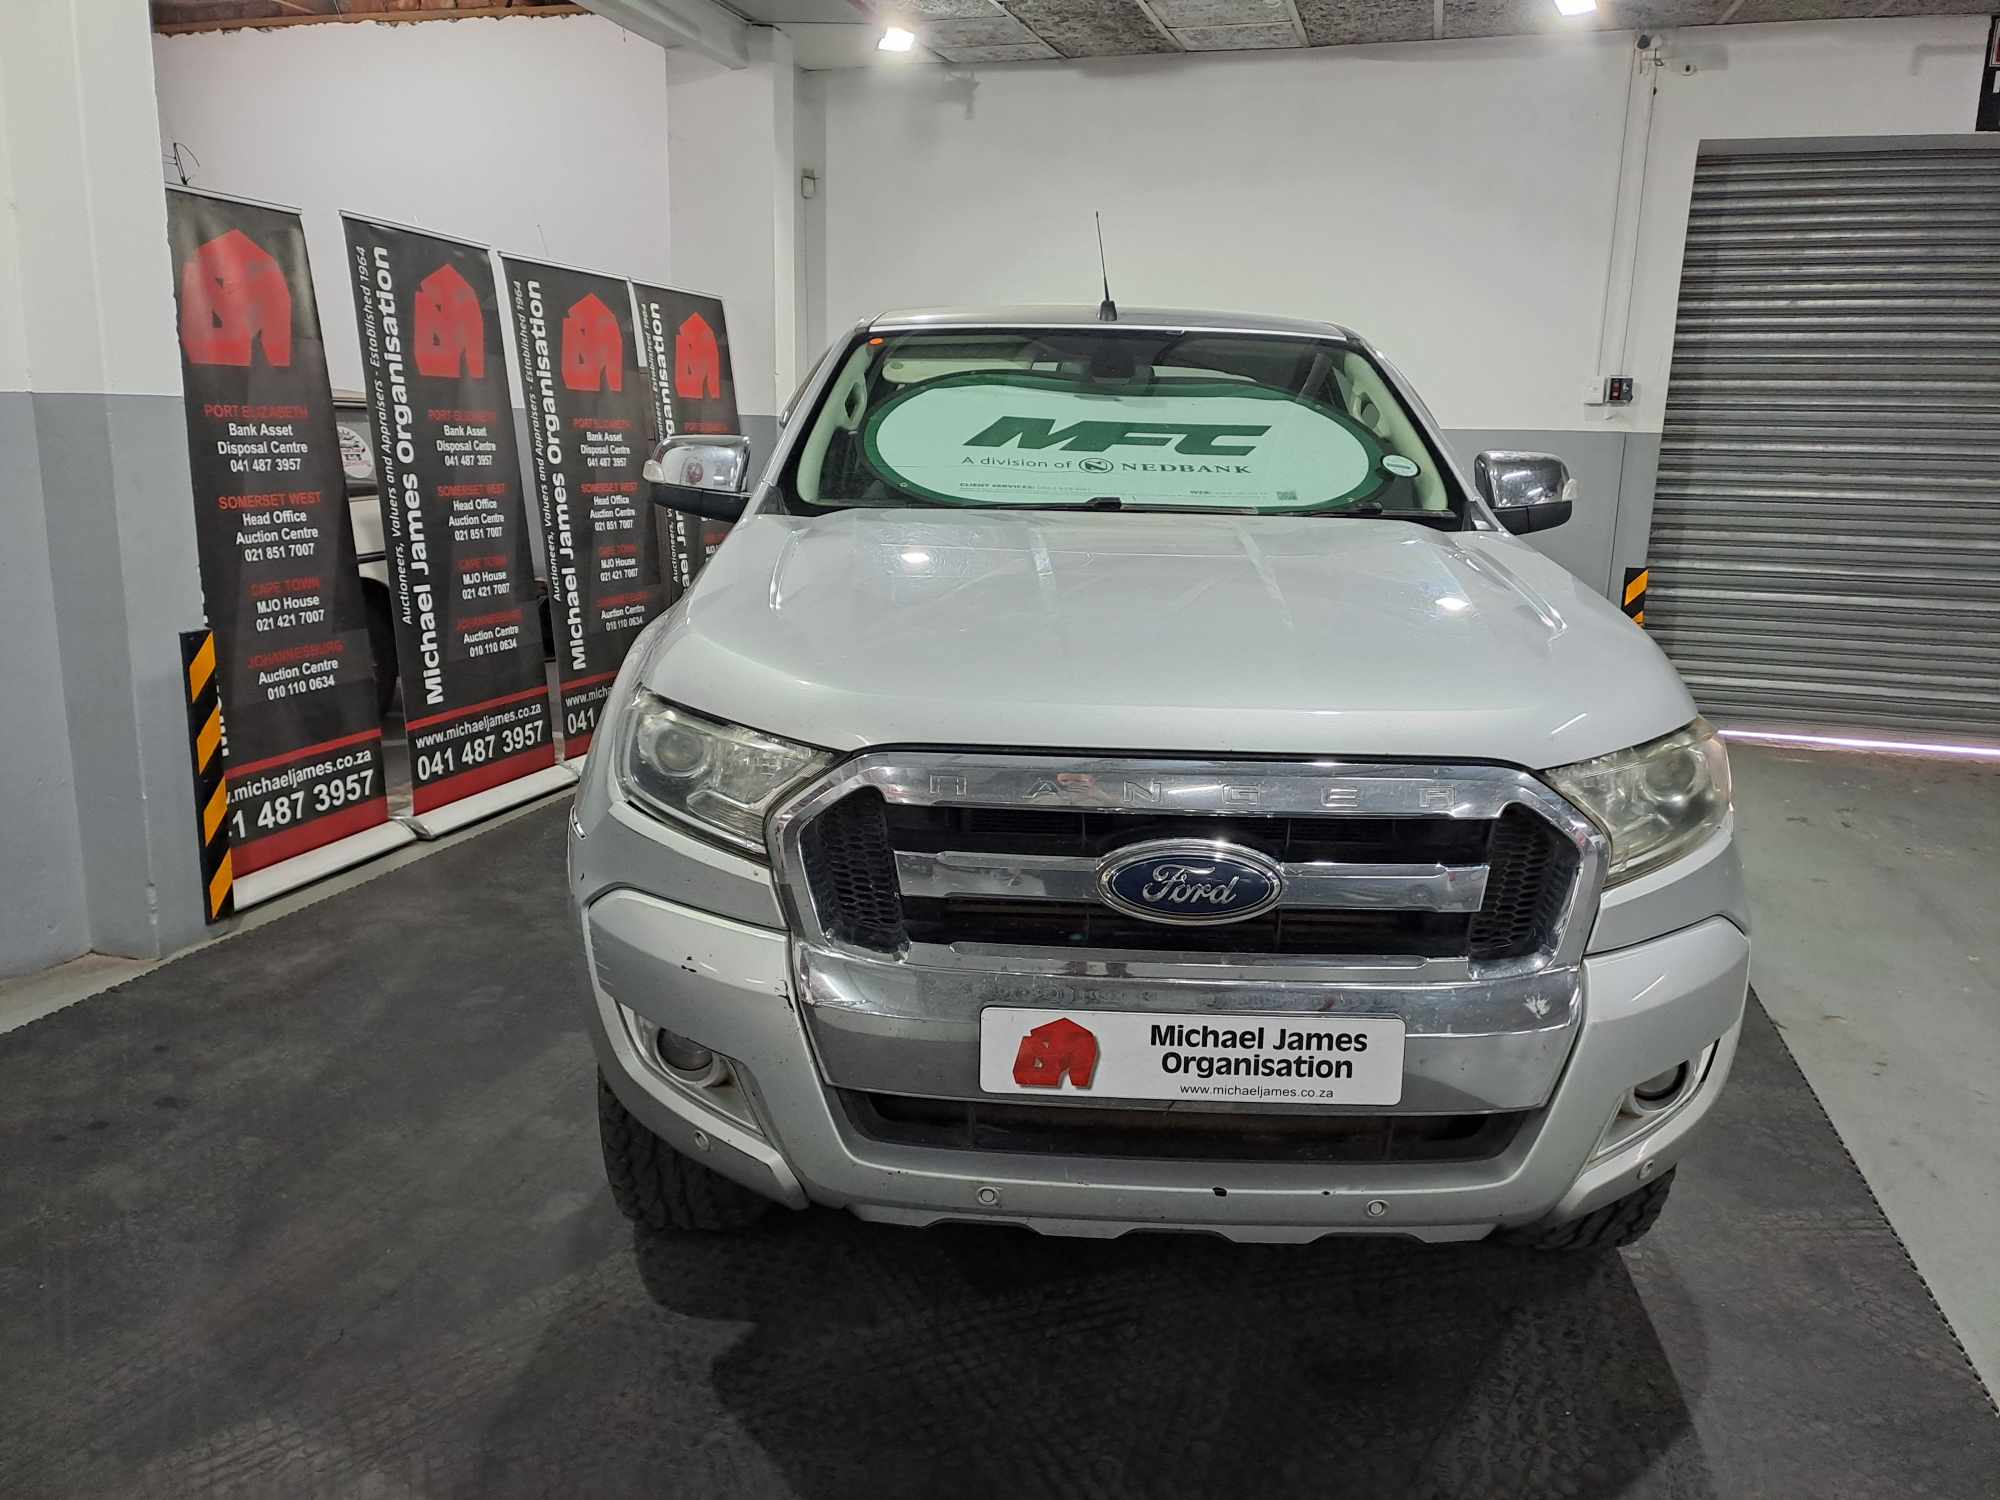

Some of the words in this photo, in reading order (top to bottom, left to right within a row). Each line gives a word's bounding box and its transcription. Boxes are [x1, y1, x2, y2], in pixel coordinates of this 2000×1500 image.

[355, 245, 370, 282] 1964
[359, 284, 381, 367] Established
[373, 246, 415, 464] Organisation
[527, 280, 562, 465] Organisation
[374, 379, 392, 453] Appraisers
[228, 423, 258, 437] Bank
[260, 423, 293, 437] Asset
[443, 425, 465, 437] Bank
[466, 426, 487, 437] Asset
[962, 415, 1272, 456] MFC
[217, 441, 268, 456] Disposal
[270, 441, 308, 454] Centre
[436, 440, 472, 453] Disposal
[473, 441, 497, 451] Centre
[230, 460, 249, 473] 041
[252, 459, 272, 472] 487
[275, 458, 302, 472] 3957
[383, 456, 395, 484] and
[444, 455, 459, 466] 041
[536, 458, 547, 481] and
[962, 456, 975, 465] A
[980, 456, 1048, 469] division
[1054, 460, 1073, 469] of
[1122, 463, 1252, 474] NEDBANK
[218, 493, 287, 509] SOMERSET
[288, 491, 321, 505] WEST
[387, 486, 402, 538] Valuers
[453, 500, 473, 511] Head
[475, 498, 497, 510] Office
[541, 484, 552, 527] Valuers
[242, 512, 271, 526] Head
[273, 510, 308, 524] Office
[402, 474, 429, 576] James
[448, 514, 480, 527] Auction
[481, 512, 505, 524] Centre
[552, 472, 574, 560] James
[235, 530, 279, 545] Auction
[281, 526, 319, 540] Centre
[454, 530, 469, 541] 021
[244, 548, 264, 562] 021
[266, 546, 286, 560] 851
[288, 543, 315, 557] 7007
[462, 573, 481, 585] MJO
[482, 571, 507, 583] House
[547, 531, 561, 602] Auctioneers,
[395, 542, 412, 625] Auctioneers,
[462, 588, 476, 600] 021
[477, 586, 491, 596] 421
[256, 599, 281, 614] MJO
[283, 596, 320, 610] House
[256, 617, 275, 632] 021
[277, 614, 297, 627] 421
[299, 609, 325, 624] 7007
[562, 567, 586, 671] Michael
[413, 584, 444, 705] Michael
[463, 629, 494, 644] Auction
[495, 624, 519, 637] Centre
[258, 667, 300, 685] Auction
[302, 659, 339, 675] Centre
[267, 686, 286, 701] 010
[288, 680, 307, 695] 110
[309, 674, 335, 691] 0634
[415, 703, 542, 749] www.michaeljames.co.za
[567, 706, 595, 735] 041
[417, 747, 455, 781] 041
[461, 735, 496, 765] 487
[502, 720, 544, 753] 3957
[257, 791, 305, 830] 487
[313, 769, 375, 812] 3957
[929, 774, 1457, 808] RANGER
[1142, 863, 1240, 904] Ford
[1150, 1024, 1265, 1051] Michael
[1273, 1028, 1369, 1052] James
[1161, 1051, 1354, 1080] Organisation
[1180, 1085, 1334, 1099] www.michaeljames.co.za
